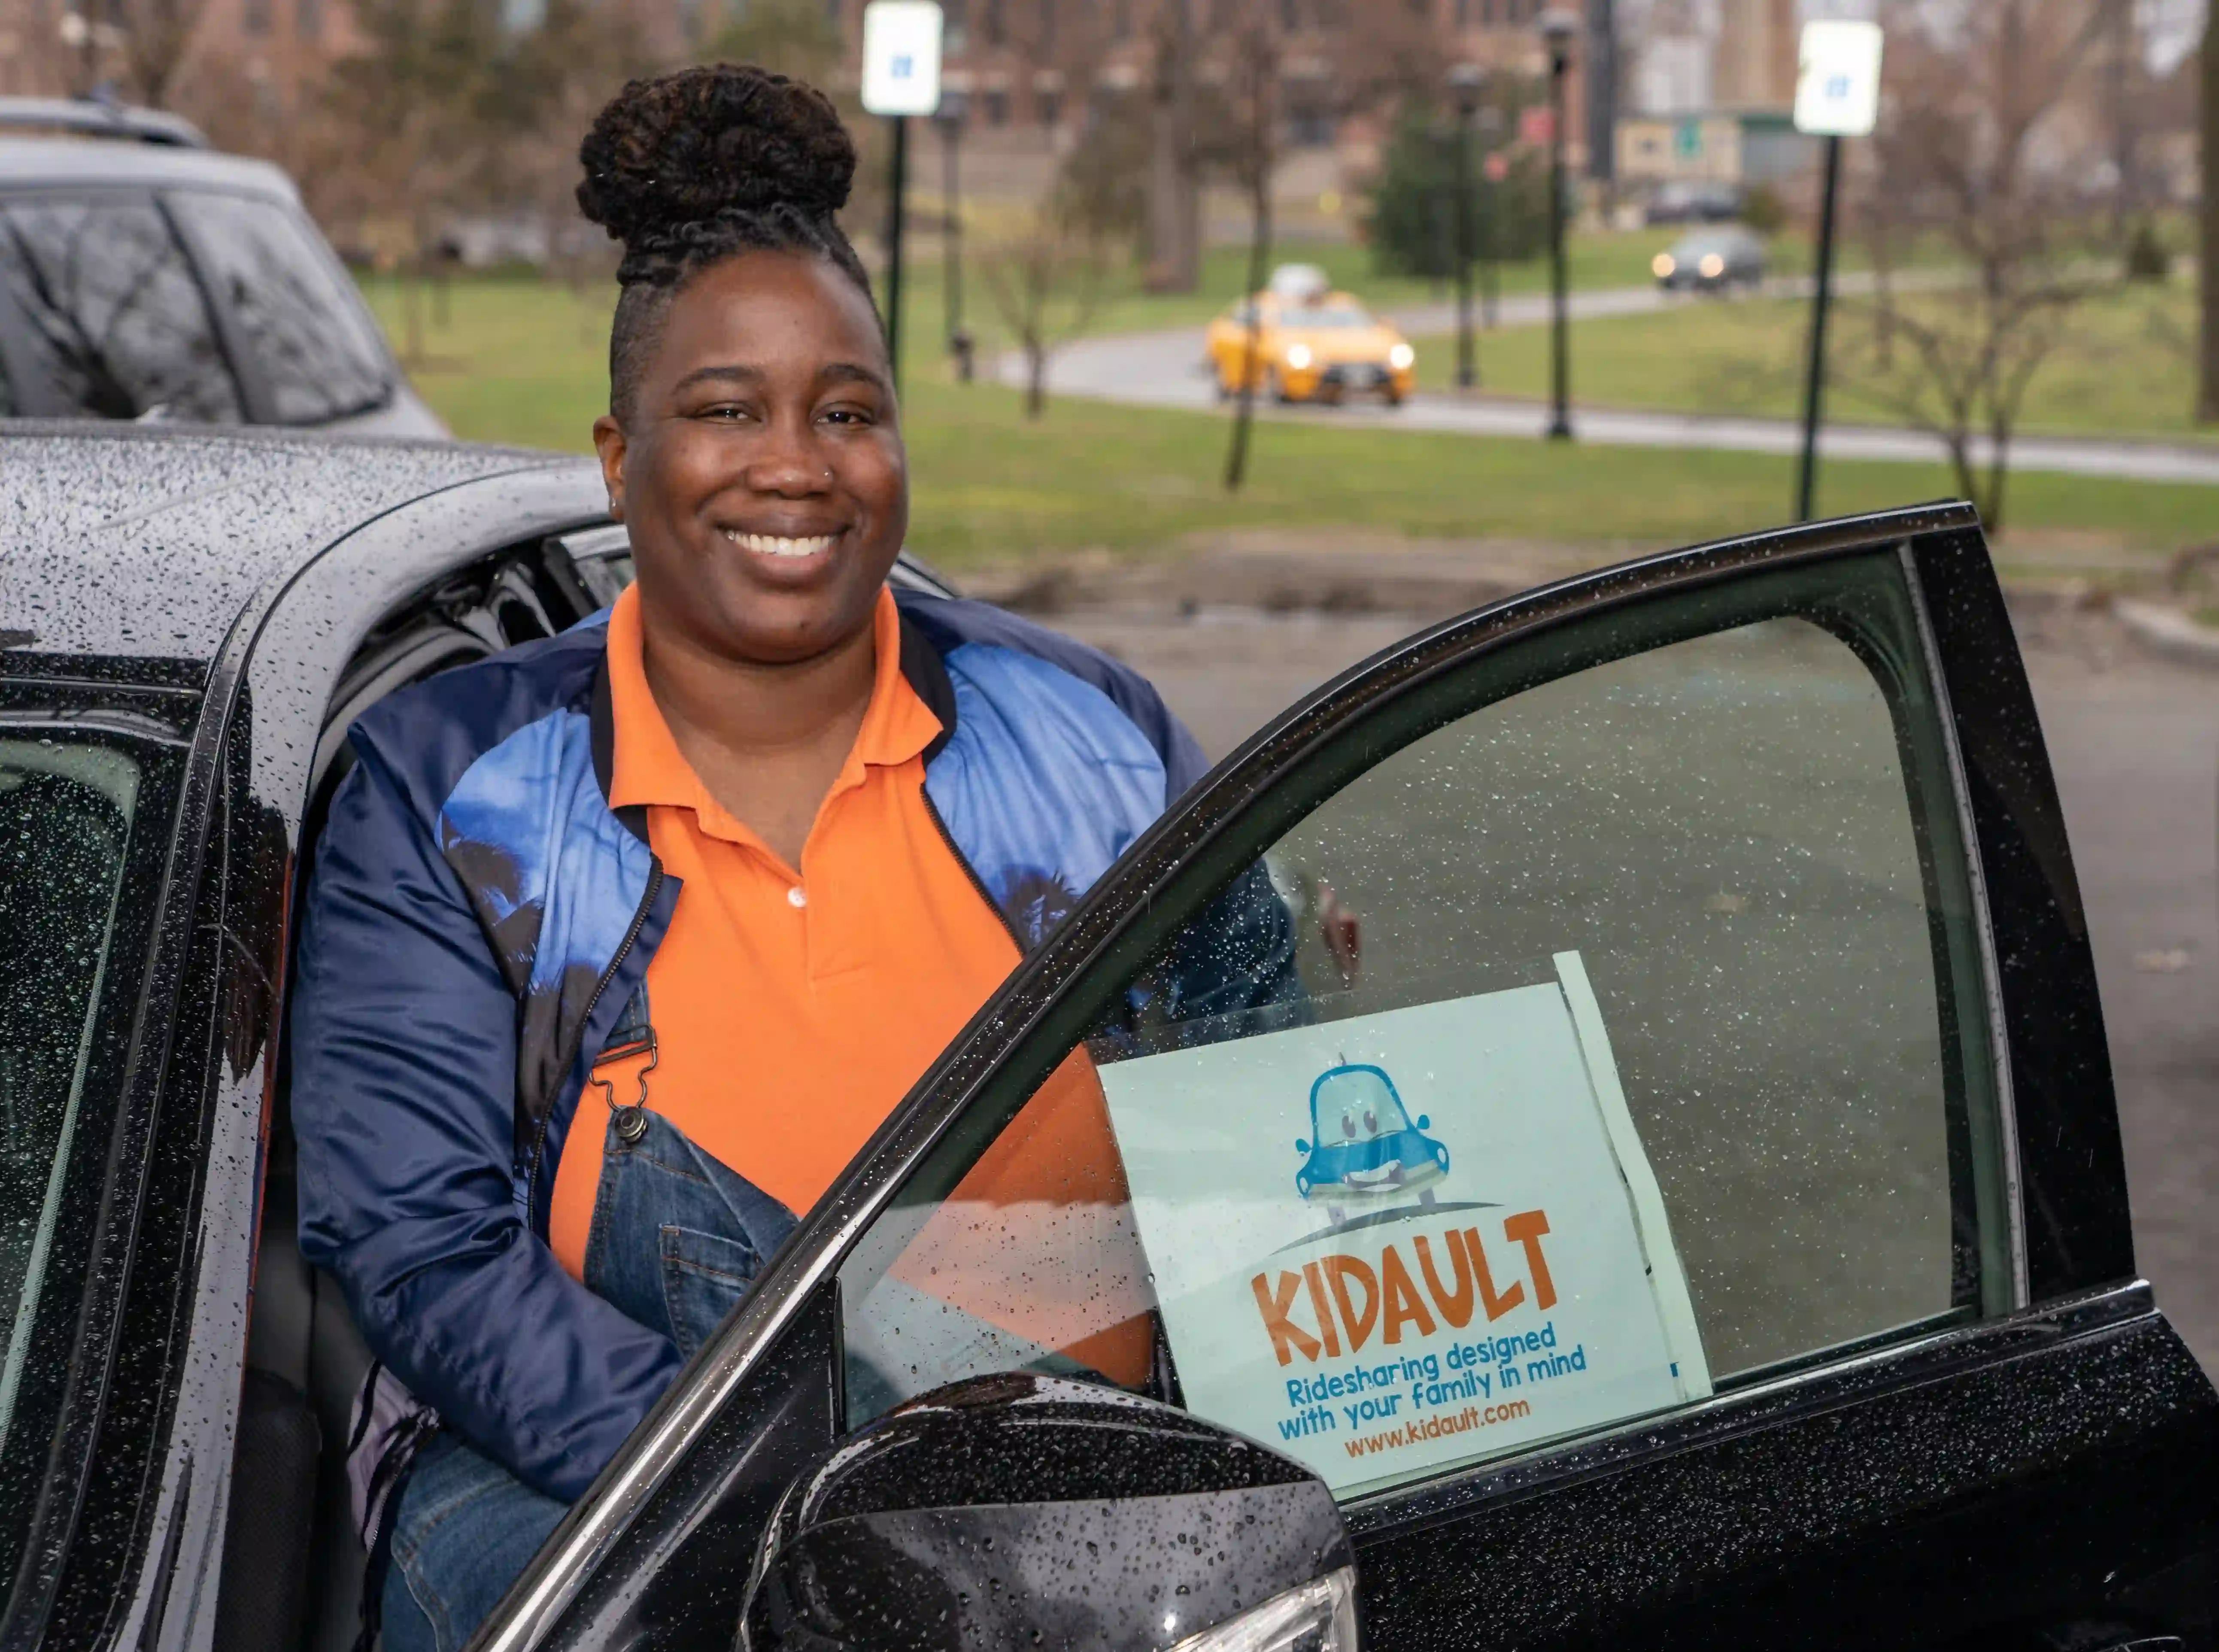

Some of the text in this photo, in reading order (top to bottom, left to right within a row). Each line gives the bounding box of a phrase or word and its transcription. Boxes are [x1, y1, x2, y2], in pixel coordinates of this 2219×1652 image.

[1251, 1209, 1557, 1367] KIDAULT
[1278, 1344, 1587, 1440] with your family in mind
[1287, 1321, 1556, 1407] Ridesharing designed
[1345, 1400, 1530, 1458] www.kidault.com
